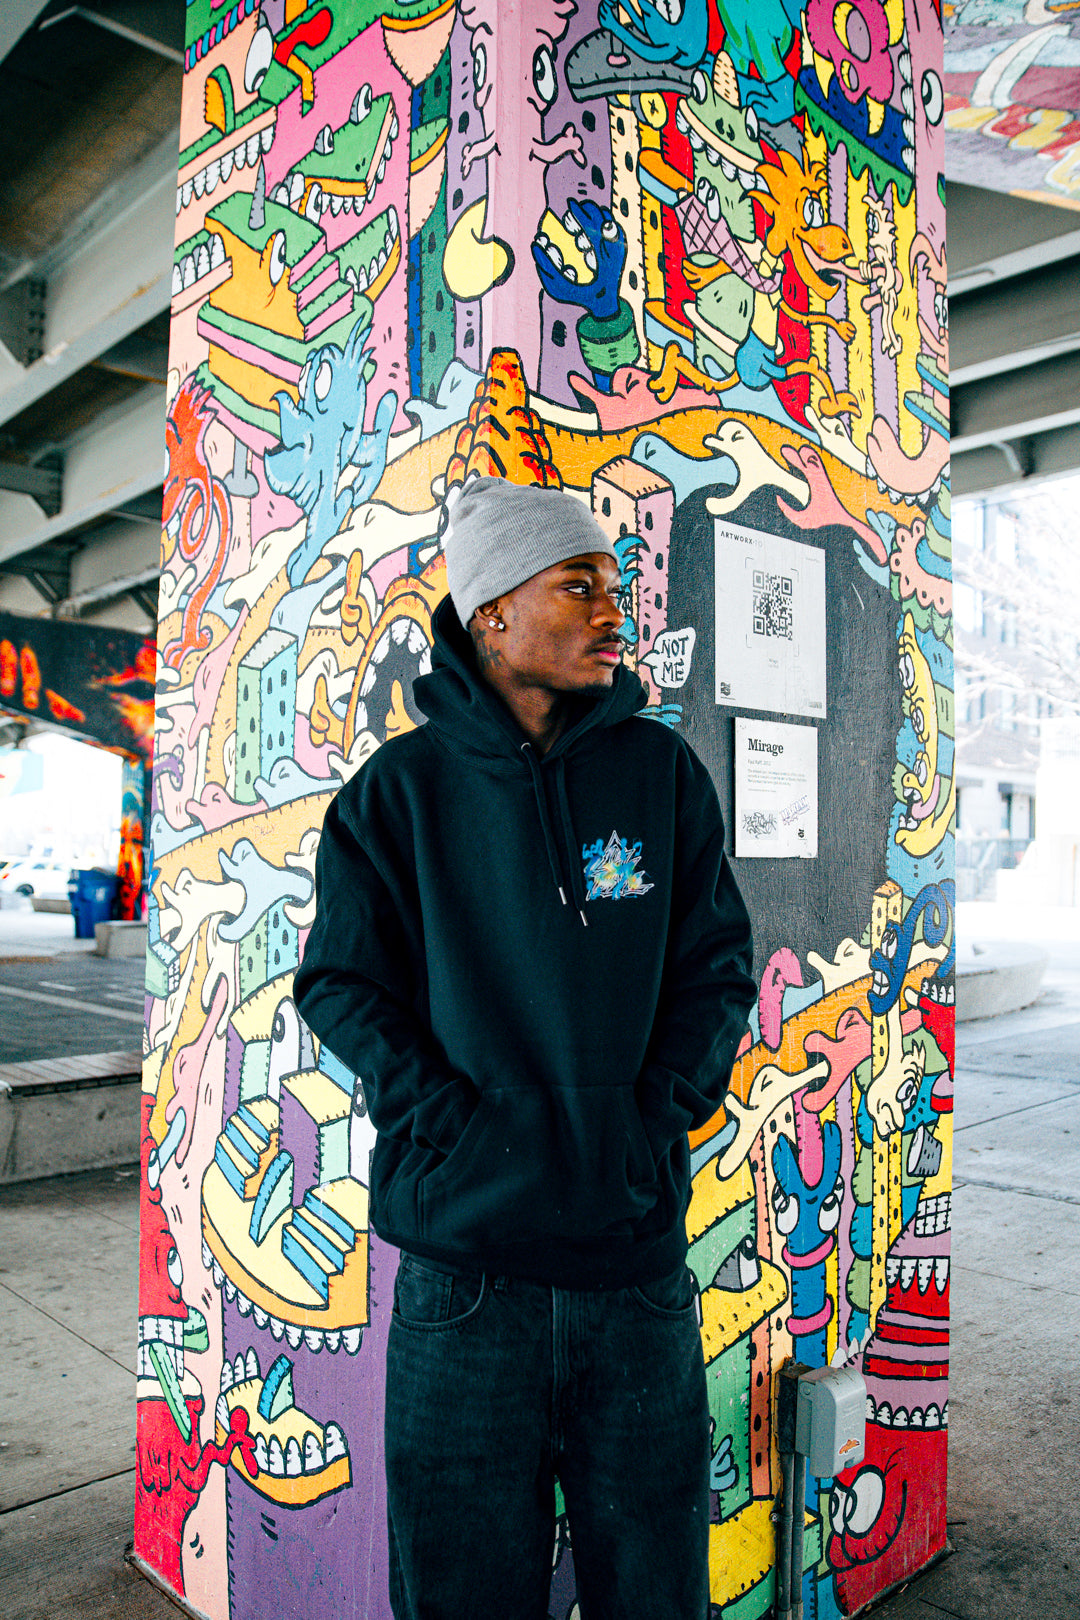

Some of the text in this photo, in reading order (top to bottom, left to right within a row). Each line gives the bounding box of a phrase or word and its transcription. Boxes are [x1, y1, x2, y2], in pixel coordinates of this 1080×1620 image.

[660, 636, 689, 659] NOT
[660, 659, 685, 683] ME
[748, 738, 784, 757] Mirage
